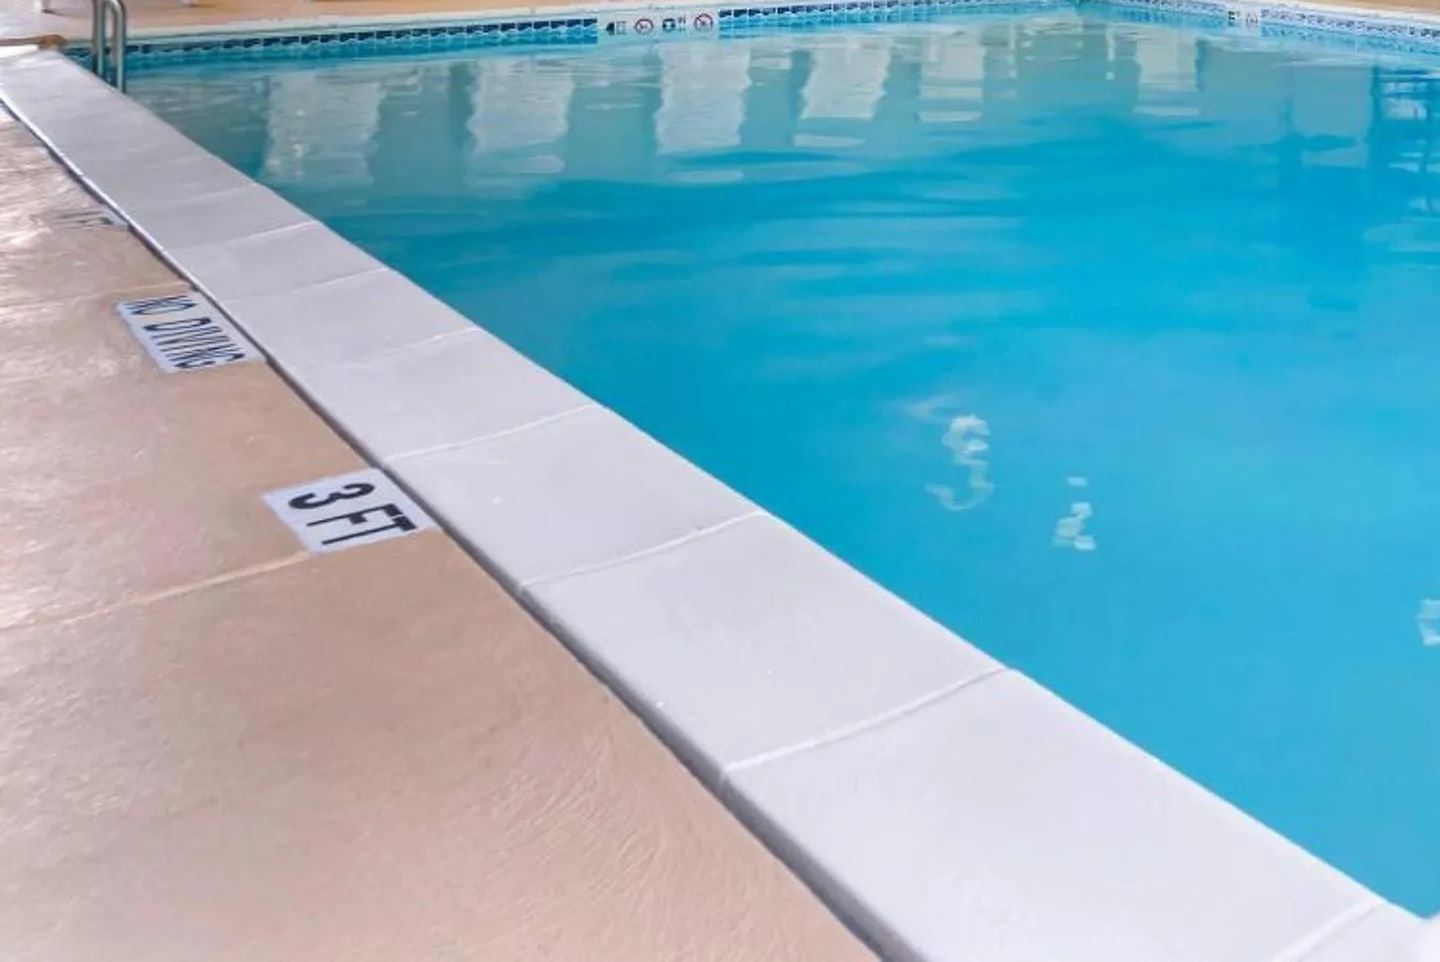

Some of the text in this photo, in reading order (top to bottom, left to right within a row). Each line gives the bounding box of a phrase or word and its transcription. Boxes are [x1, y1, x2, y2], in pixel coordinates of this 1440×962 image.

[122, 295, 246, 369] NO DIVING
[288, 482, 418, 545] 3 FT
